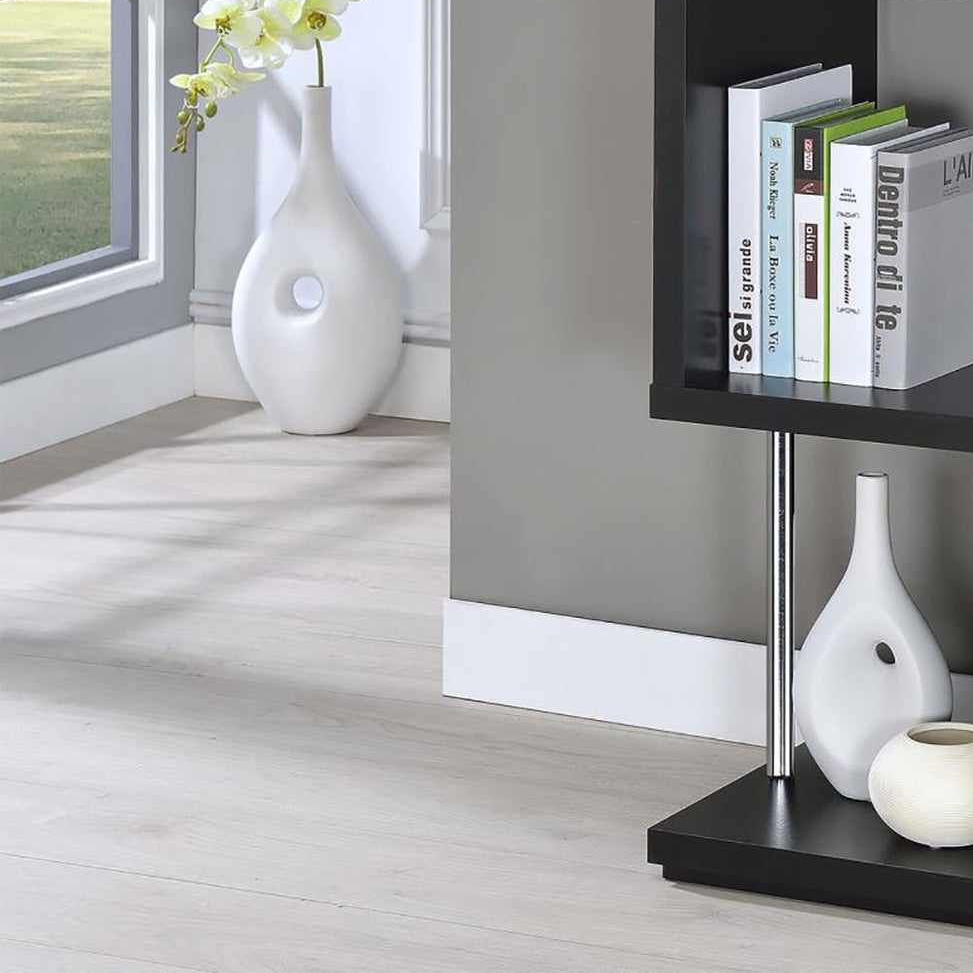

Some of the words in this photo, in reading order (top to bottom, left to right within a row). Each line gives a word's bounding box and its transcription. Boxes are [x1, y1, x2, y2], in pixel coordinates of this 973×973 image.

[769, 161, 779, 187] Noah
[877, 165, 905, 256] Dentro
[769, 235, 779, 252] La
[805, 227, 814, 262] olivia
[843, 222, 852, 250] Anna
[739, 238, 754, 292] grande
[769, 257, 779, 290] Boxe
[876, 265, 903, 291] di
[843, 253, 852, 304] Karenina
[739, 296, 751, 309] si
[769, 294, 777, 311] ou
[769, 315, 779, 326] la
[875, 305, 902, 330] te
[768, 331, 779, 353] Vie
